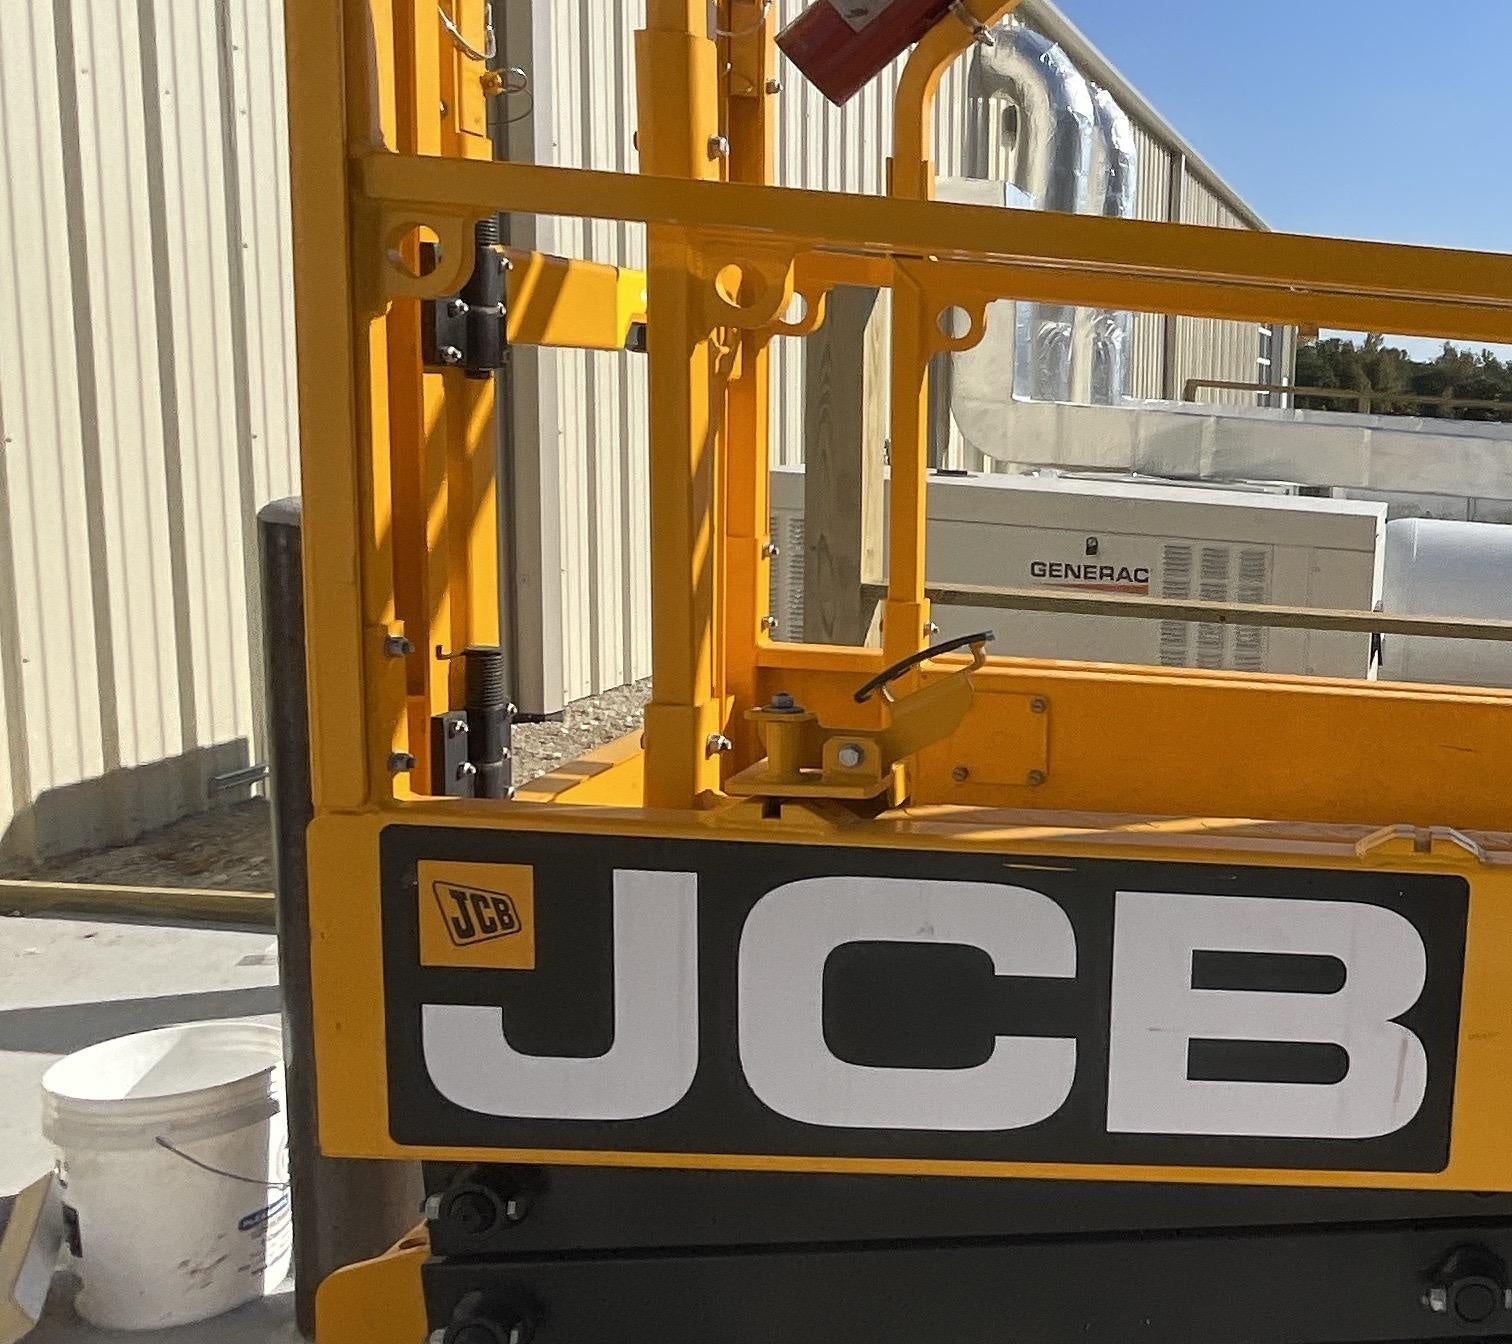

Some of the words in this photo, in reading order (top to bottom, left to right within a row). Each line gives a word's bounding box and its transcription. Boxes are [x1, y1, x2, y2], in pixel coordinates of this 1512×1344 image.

[1030, 561, 1149, 583] GENERAC
[448, 888, 515, 940] JCB
[420, 867, 1428, 1140] JCB
